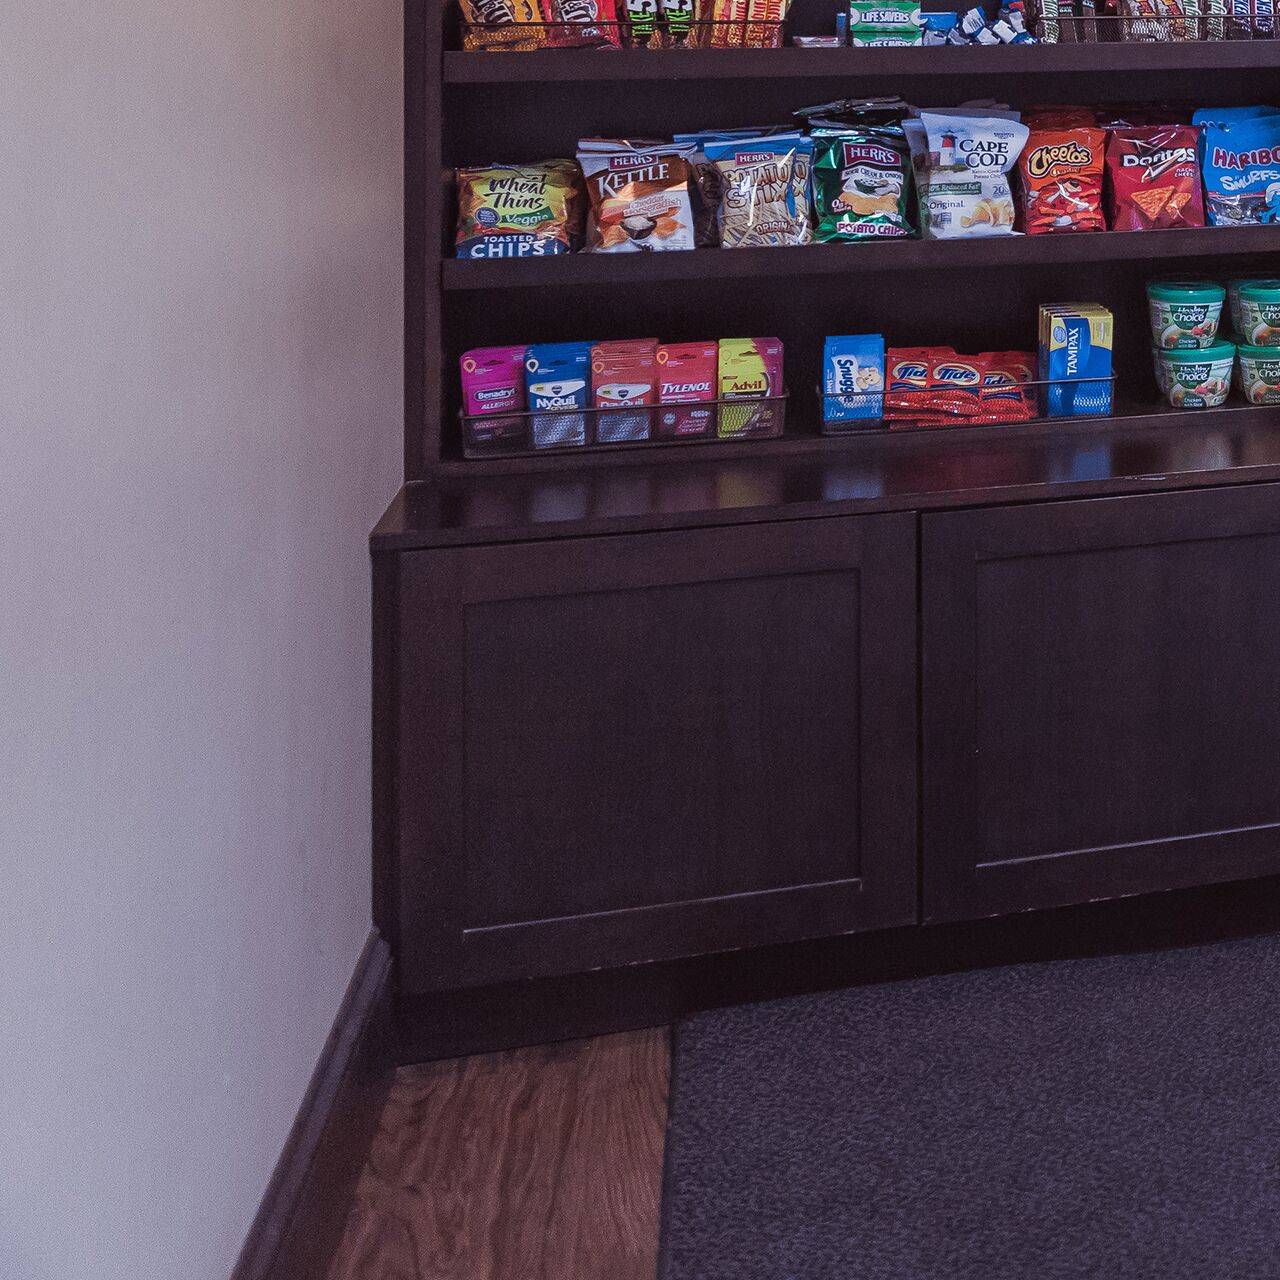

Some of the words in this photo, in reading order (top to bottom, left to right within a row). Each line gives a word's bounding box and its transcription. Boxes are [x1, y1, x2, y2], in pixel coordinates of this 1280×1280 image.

[862, 12, 879, 23] LIFE
[878, 12, 910, 23] SAVERS
[959, 139, 1009, 154] CAPE
[740, 154, 771, 163] HERR'S
[850, 147, 896, 163] HERR'S
[965, 152, 1008, 169] COD
[1028, 142, 1092, 179] Cheetos
[1123, 148, 1195, 168] Doritos
[860, 167, 878, 179] CREAM
[885, 172, 902, 180] ONION
[488, 174, 549, 196] Wheat
[597, 163, 669, 198] KETTLE
[941, 184, 968, 192] Reduced
[968, 183, 980, 191] Fat
[484, 192, 545, 209] Thins
[631, 195, 665, 208] Cheddar
[623, 199, 683, 216] Horseradish
[504, 211, 549, 227] Veggie
[877, 223, 907, 236] CHIPS
[484, 235, 534, 243] TOASTED
[471, 242, 545, 257] CHIPS
[1172, 312, 1205, 322] Choice
[1177, 306, 1208, 315] Healthy
[1066, 328, 1079, 375] TAMPAX
[938, 368, 977, 381] Tide
[1180, 364, 1211, 374] Healthy
[1176, 371, 1208, 381] Choice
[661, 382, 712, 395] TYLENOL
[731, 380, 762, 392] Advil
[477, 388, 517, 401] Benadryl
[480, 401, 515, 410] ALLERGY
[535, 395, 576, 409] NyQuil
